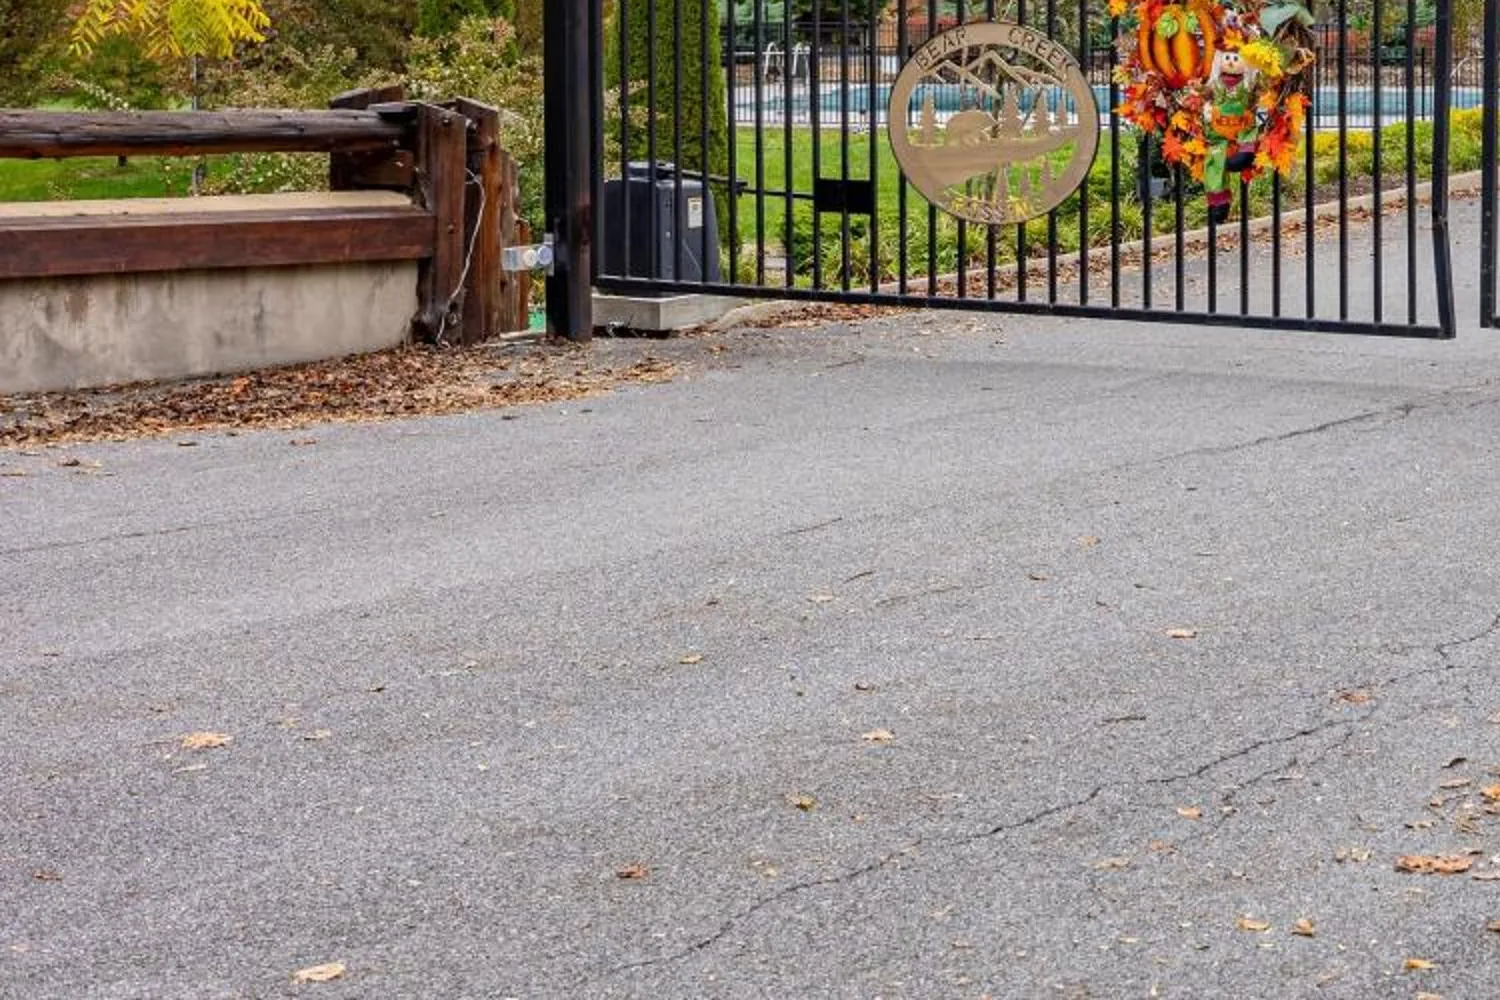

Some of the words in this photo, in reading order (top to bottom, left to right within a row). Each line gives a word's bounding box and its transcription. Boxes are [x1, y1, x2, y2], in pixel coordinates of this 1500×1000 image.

[914, 27, 967, 70] BEAR
[1008, 27, 1075, 78] CREEK
[942, 190, 1051, 221] ROSSING
